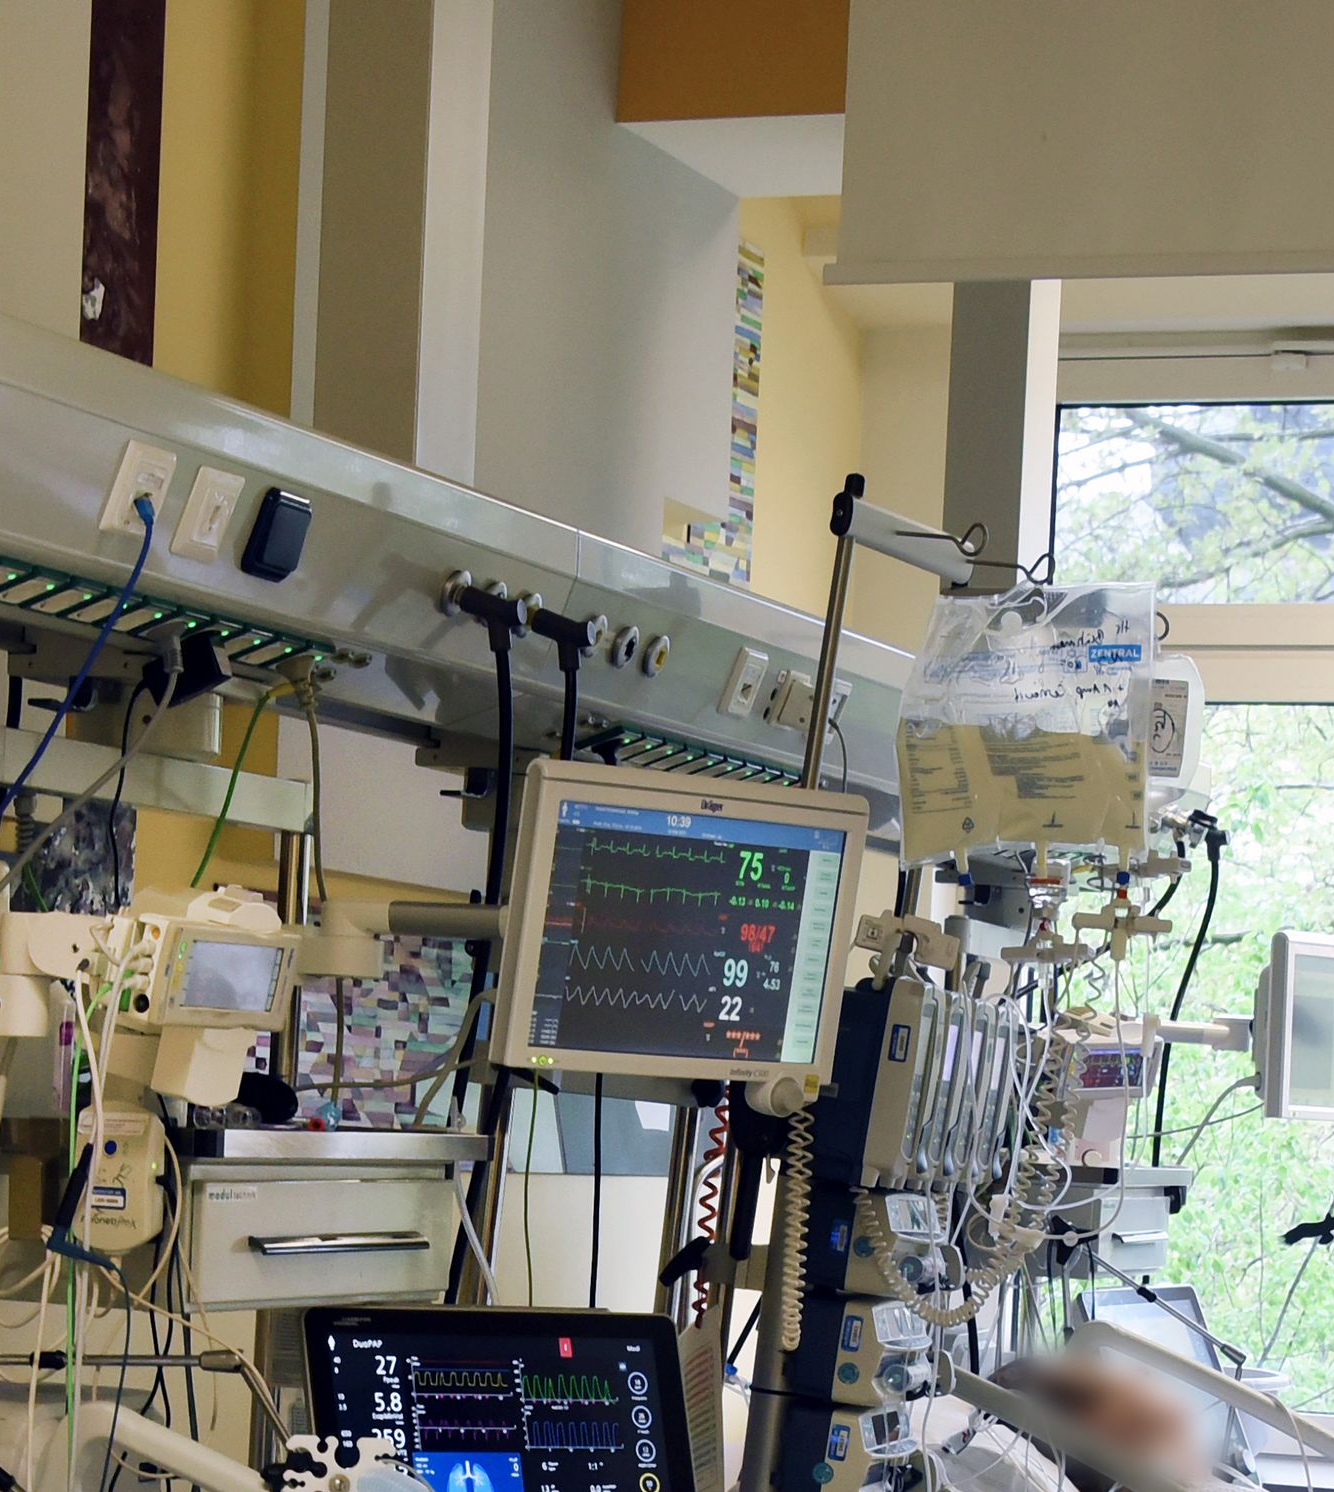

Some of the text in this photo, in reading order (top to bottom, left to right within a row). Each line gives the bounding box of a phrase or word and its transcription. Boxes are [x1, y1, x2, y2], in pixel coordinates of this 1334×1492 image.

[667, 815, 692, 829] 10:39
[739, 850, 764, 881] 75
[740, 923, 776, 944] 98/47
[722, 958, 749, 988] 99
[718, 995, 743, 1022] 22
[374, 1355, 397, 1375] 27
[374, 1392, 403, 1413] 5.8
